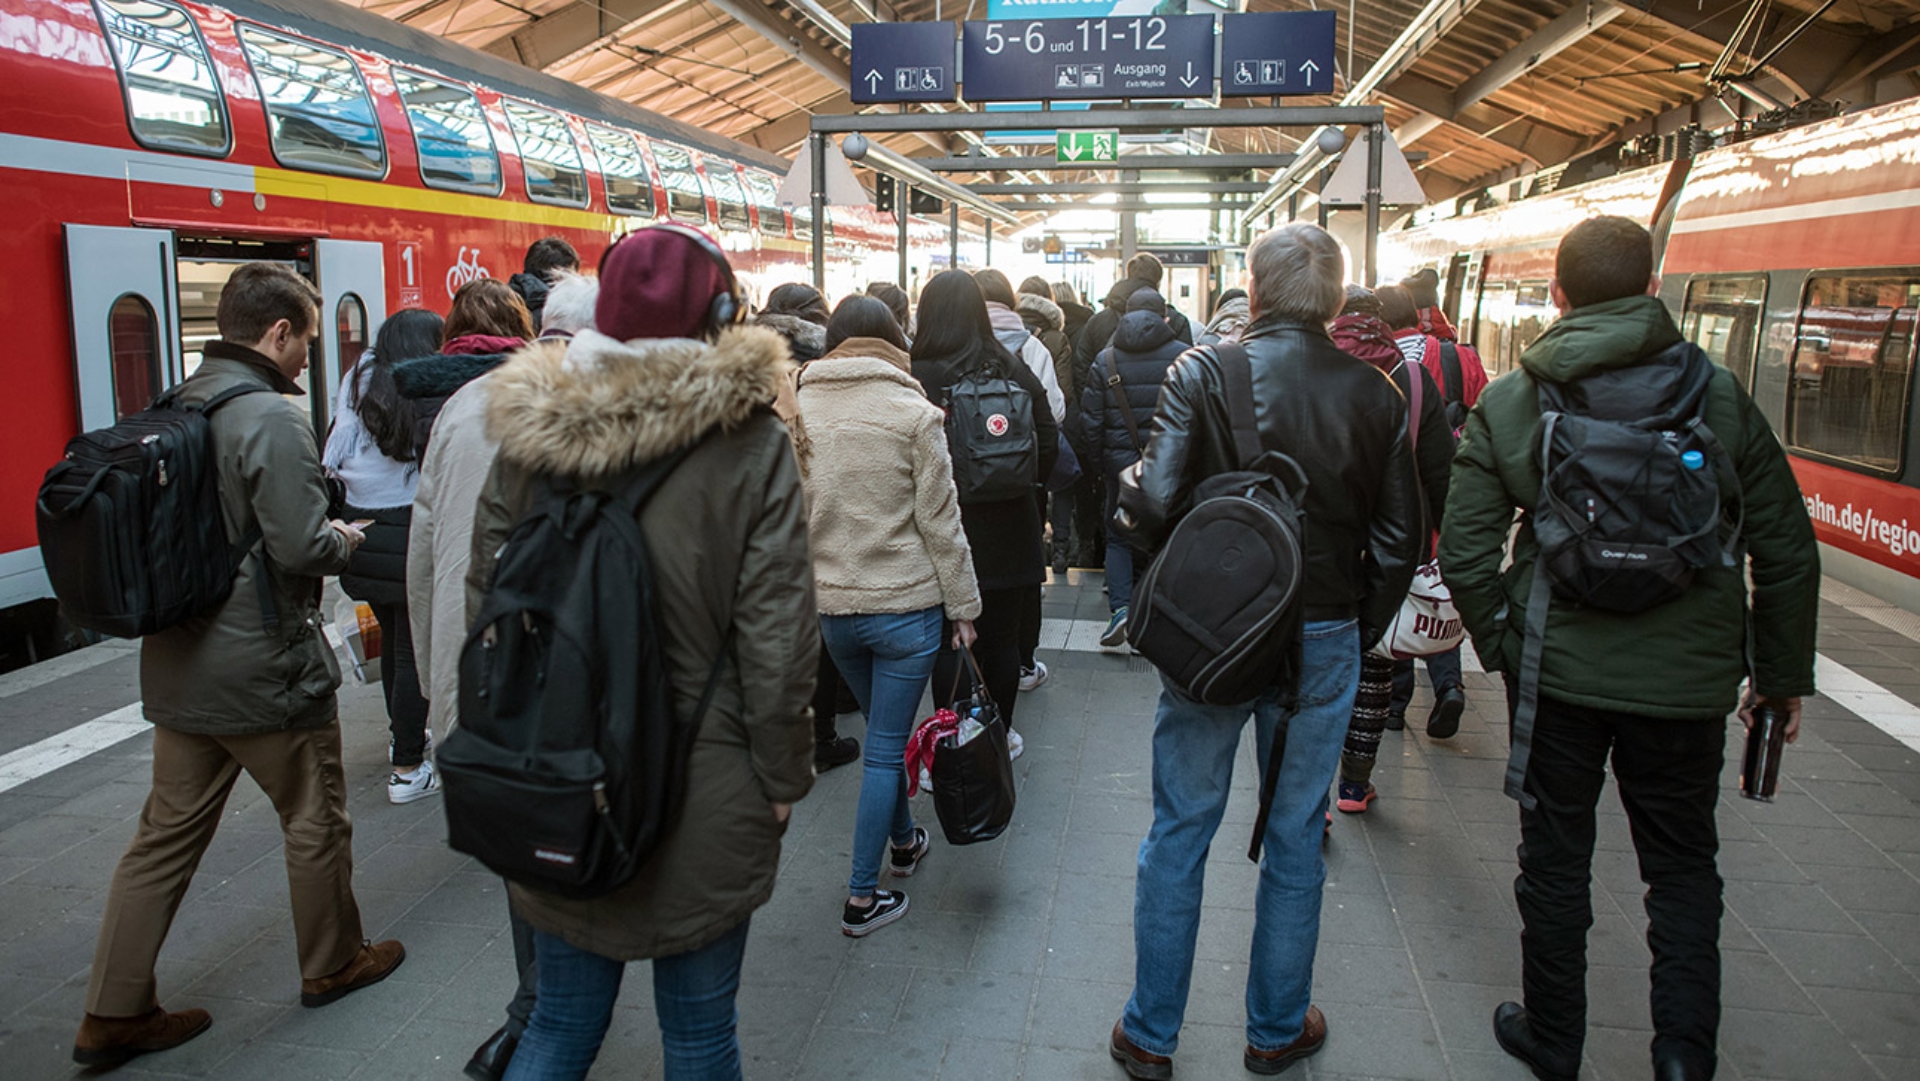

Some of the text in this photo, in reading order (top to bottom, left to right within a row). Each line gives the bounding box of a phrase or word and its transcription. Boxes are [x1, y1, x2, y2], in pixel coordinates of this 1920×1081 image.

[985, 17, 1167, 54] 5-6 und 11-12
[1113, 63, 1166, 77] Ausgang
[402, 246, 414, 286] 1
